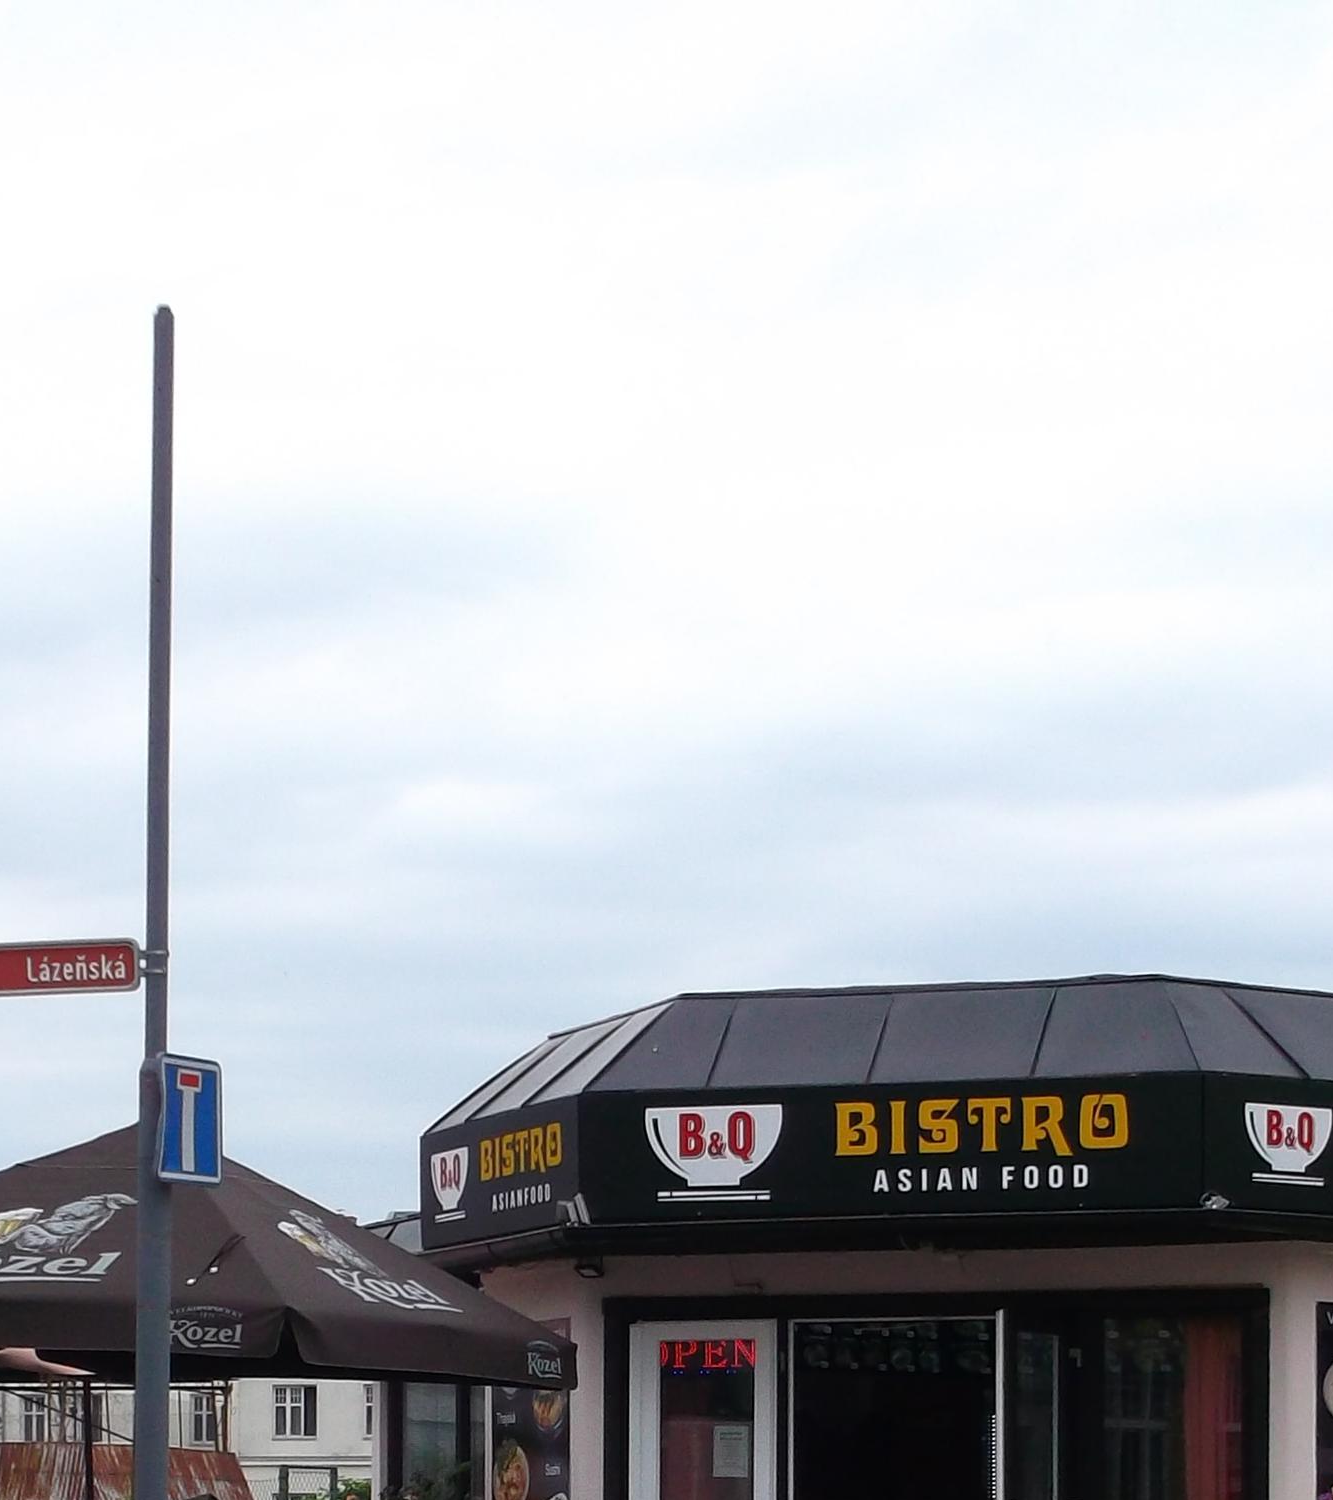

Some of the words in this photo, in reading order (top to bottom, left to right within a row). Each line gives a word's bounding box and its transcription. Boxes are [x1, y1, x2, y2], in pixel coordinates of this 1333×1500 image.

[26, 954, 126, 983] Lázeňská
[678, 1110, 756, 1164] B&Q
[834, 1093, 1130, 1157] BISTRO
[1266, 1108, 1316, 1157] B&Q
[439, 1152, 463, 1193] B&Q
[478, 1121, 564, 1183] BISTRO
[491, 1183, 552, 1214] ASIANFOOD
[872, 1166, 979, 1193] ASIAN
[1001, 1163, 1091, 1190] FOOD
[317, 1265, 463, 1313] Kozel
[527, 1352, 562, 1379] Kozel
